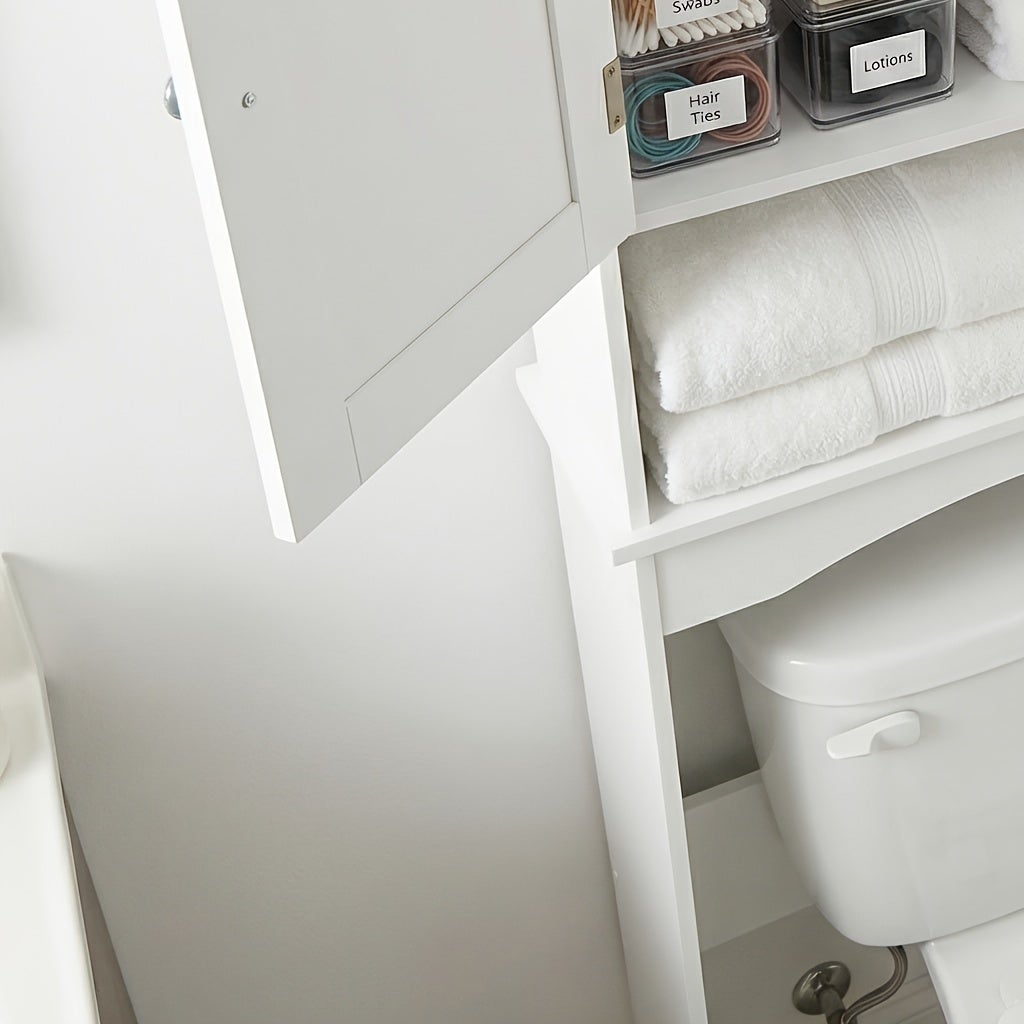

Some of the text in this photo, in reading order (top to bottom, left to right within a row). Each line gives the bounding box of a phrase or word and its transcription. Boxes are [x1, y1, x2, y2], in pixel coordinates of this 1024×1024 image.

[864, 52, 913, 73] Lotions
[689, 91, 720, 108] Hair
[691, 109, 721, 125] Ties
